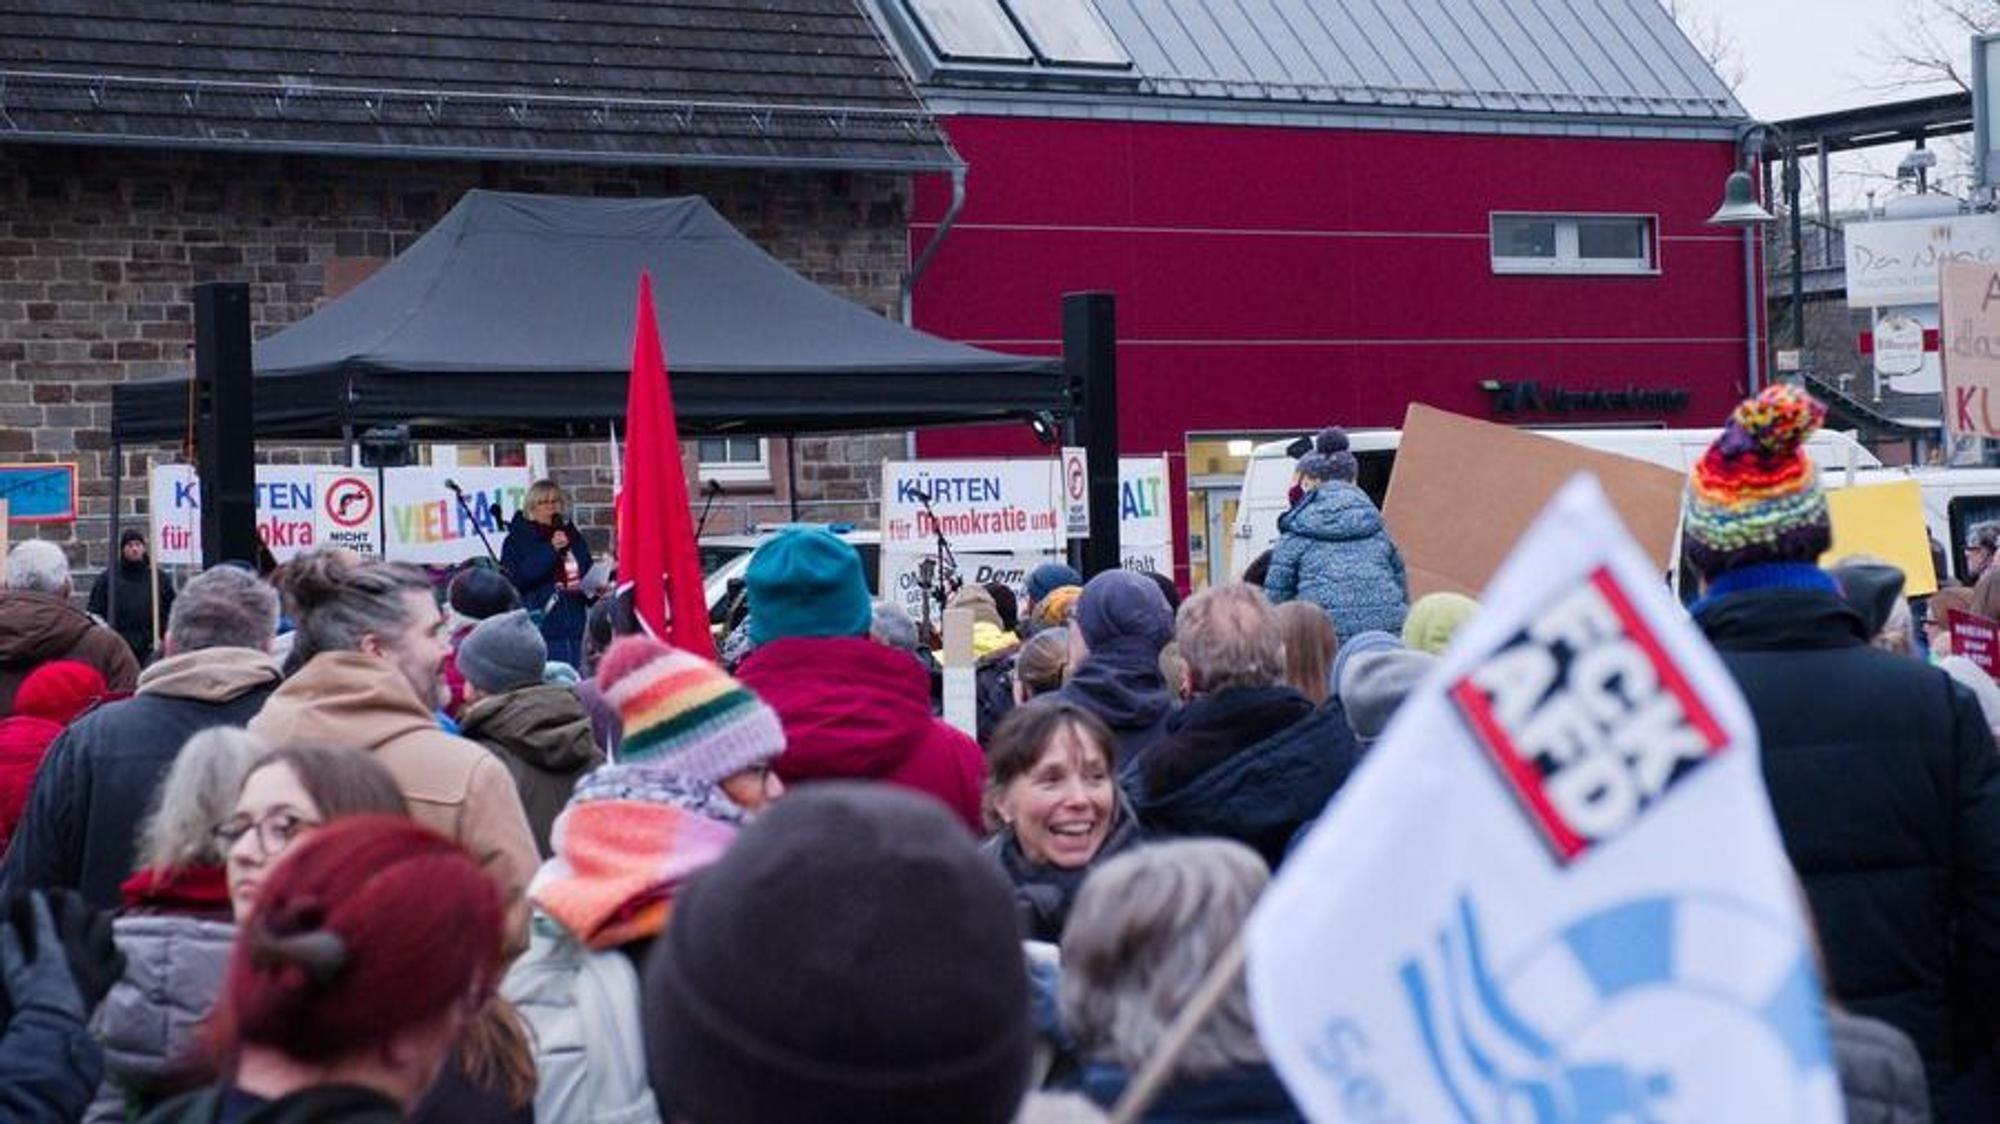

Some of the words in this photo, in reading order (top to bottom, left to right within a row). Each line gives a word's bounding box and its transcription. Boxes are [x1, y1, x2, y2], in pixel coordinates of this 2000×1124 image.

[1954, 318, 2000, 360] da
[175, 481, 313, 509] KTEN
[897, 472, 1001, 503] KÜRTEN
[1122, 475, 1160, 521] ALT
[391, 484, 526, 544] VIELFALT
[889, 519, 911, 540] für
[1031, 510, 1057, 531] und
[161, 524, 192, 549] für
[329, 531, 369, 542] NICHT
[976, 565, 1024, 584] Dem
[1529, 588, 1713, 796] FCK
[1468, 643, 1642, 836] AFD
